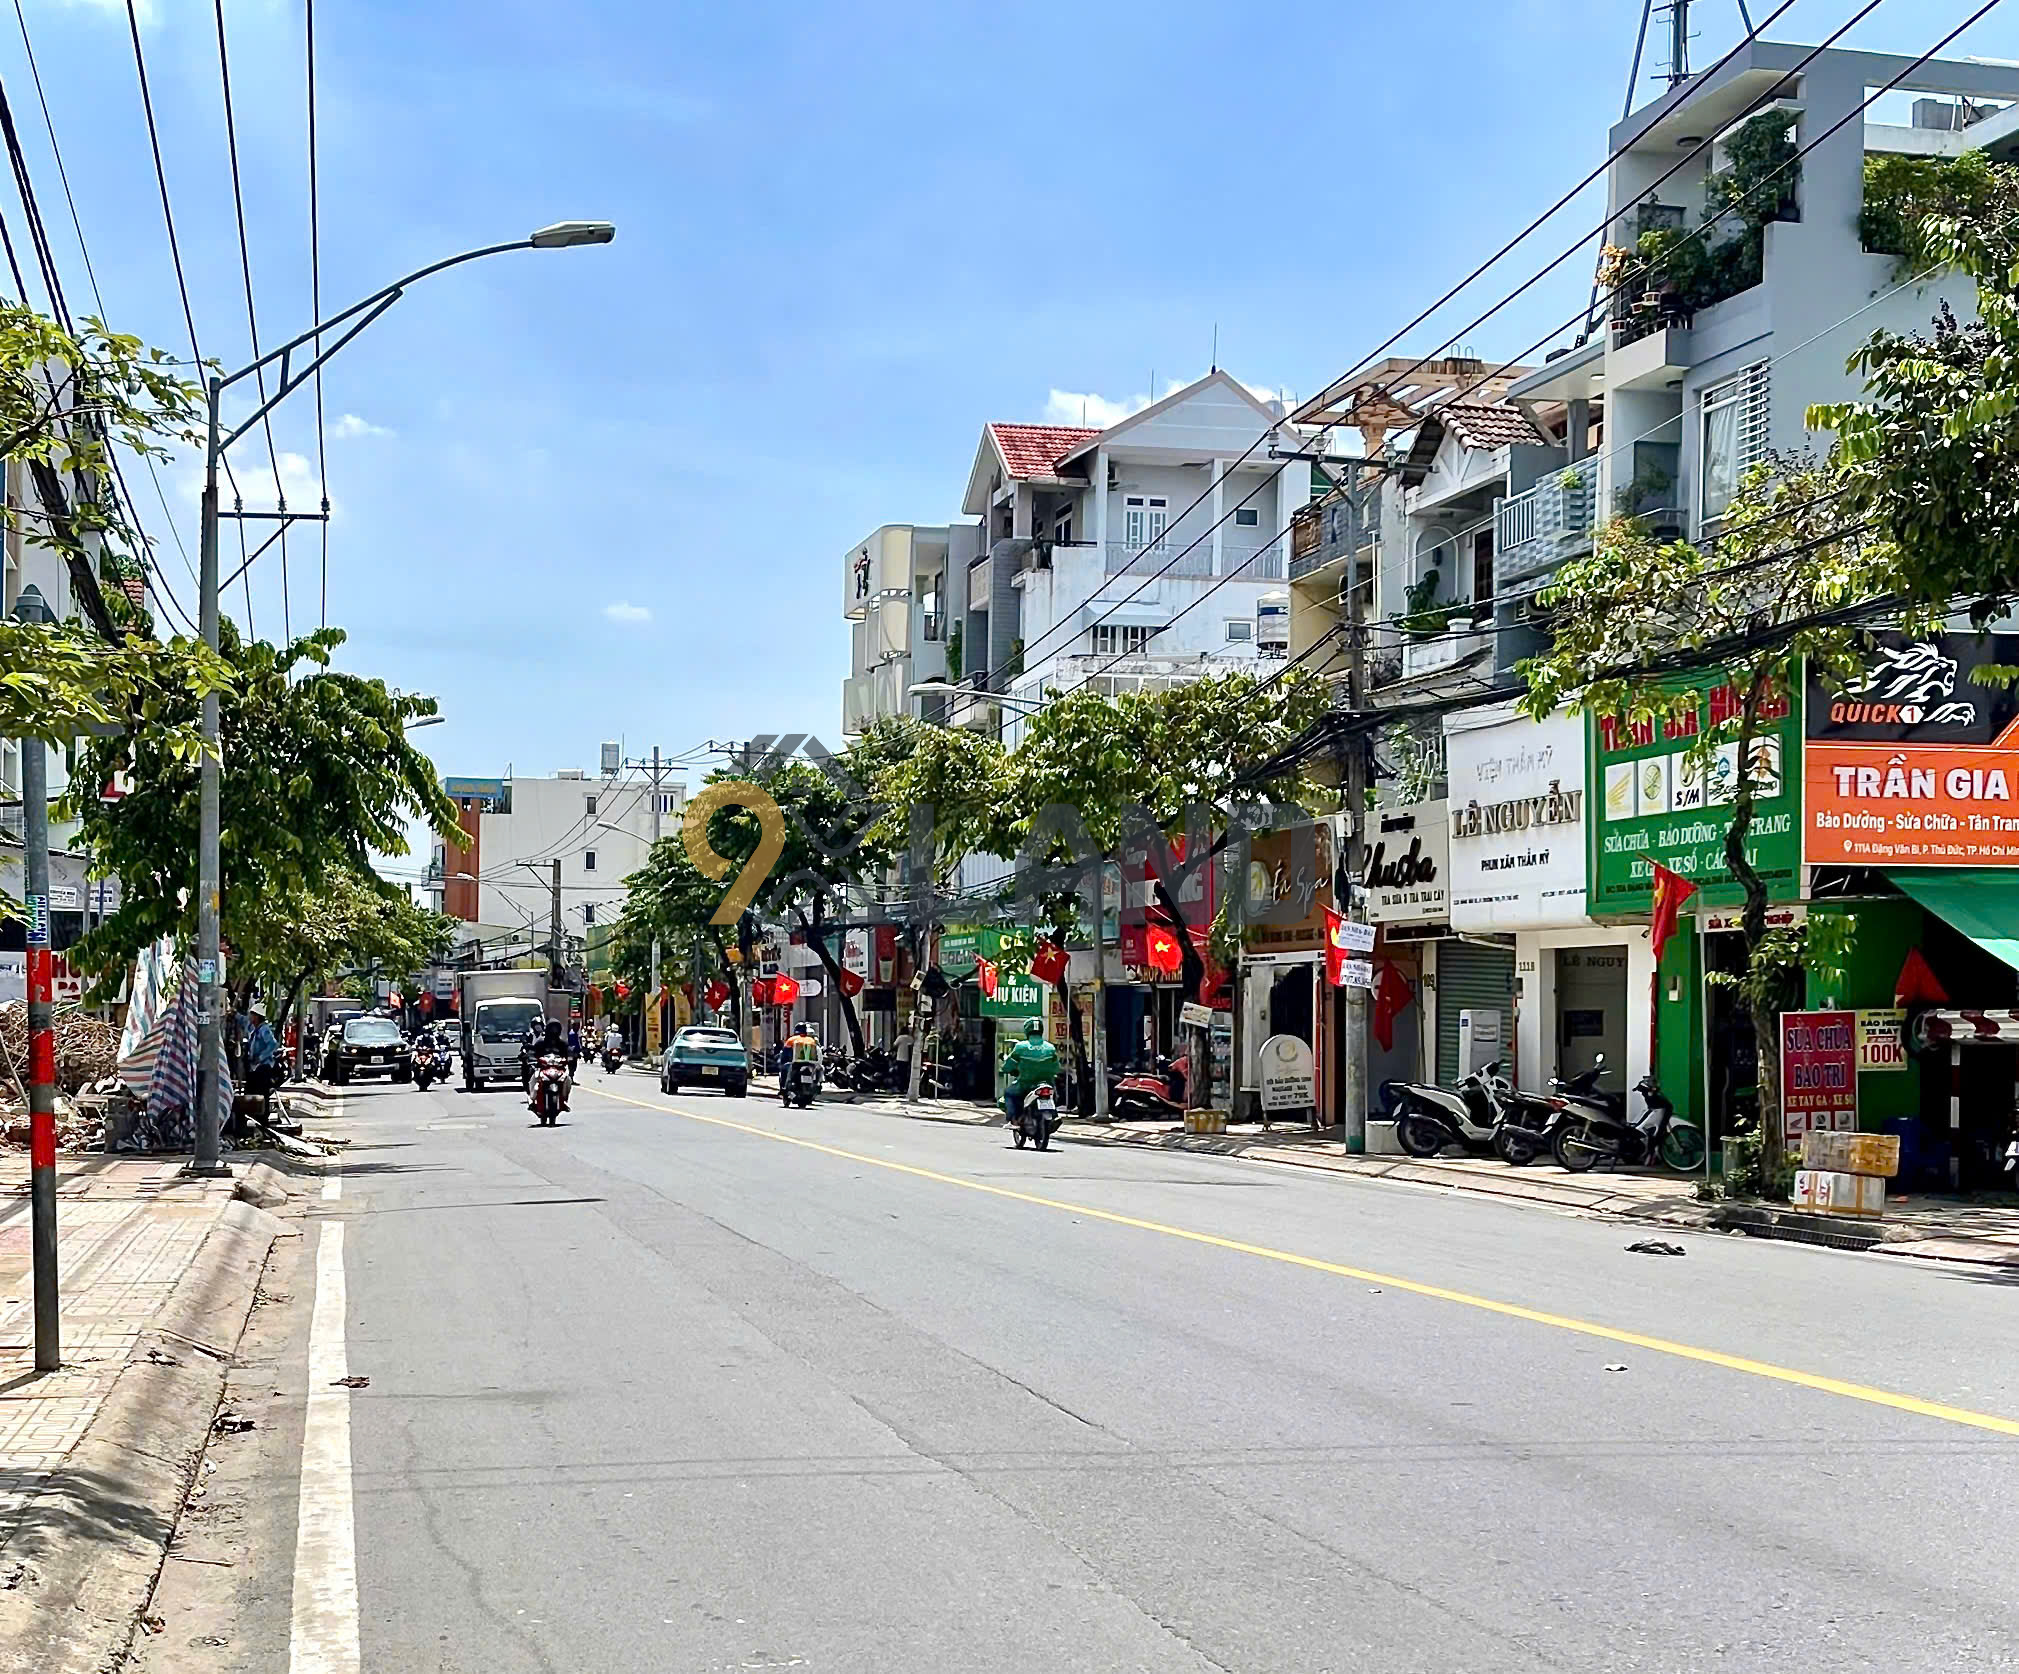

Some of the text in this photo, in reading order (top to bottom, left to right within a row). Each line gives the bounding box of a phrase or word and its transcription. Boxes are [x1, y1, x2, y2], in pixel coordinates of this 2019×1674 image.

[1832, 753, 2010, 800] TRẦN GIA
[1816, 810, 1840, 829] Bảo
[1843, 810, 1885, 833] Dưỡng
[1896, 811, 1920, 830] Sửa
[1924, 813, 1957, 830] Chữa
[1968, 815, 1990, 831] Tân
[1011, 984, 1038, 1007] KIỆN
[1860, 1043, 1904, 1064] 100K
